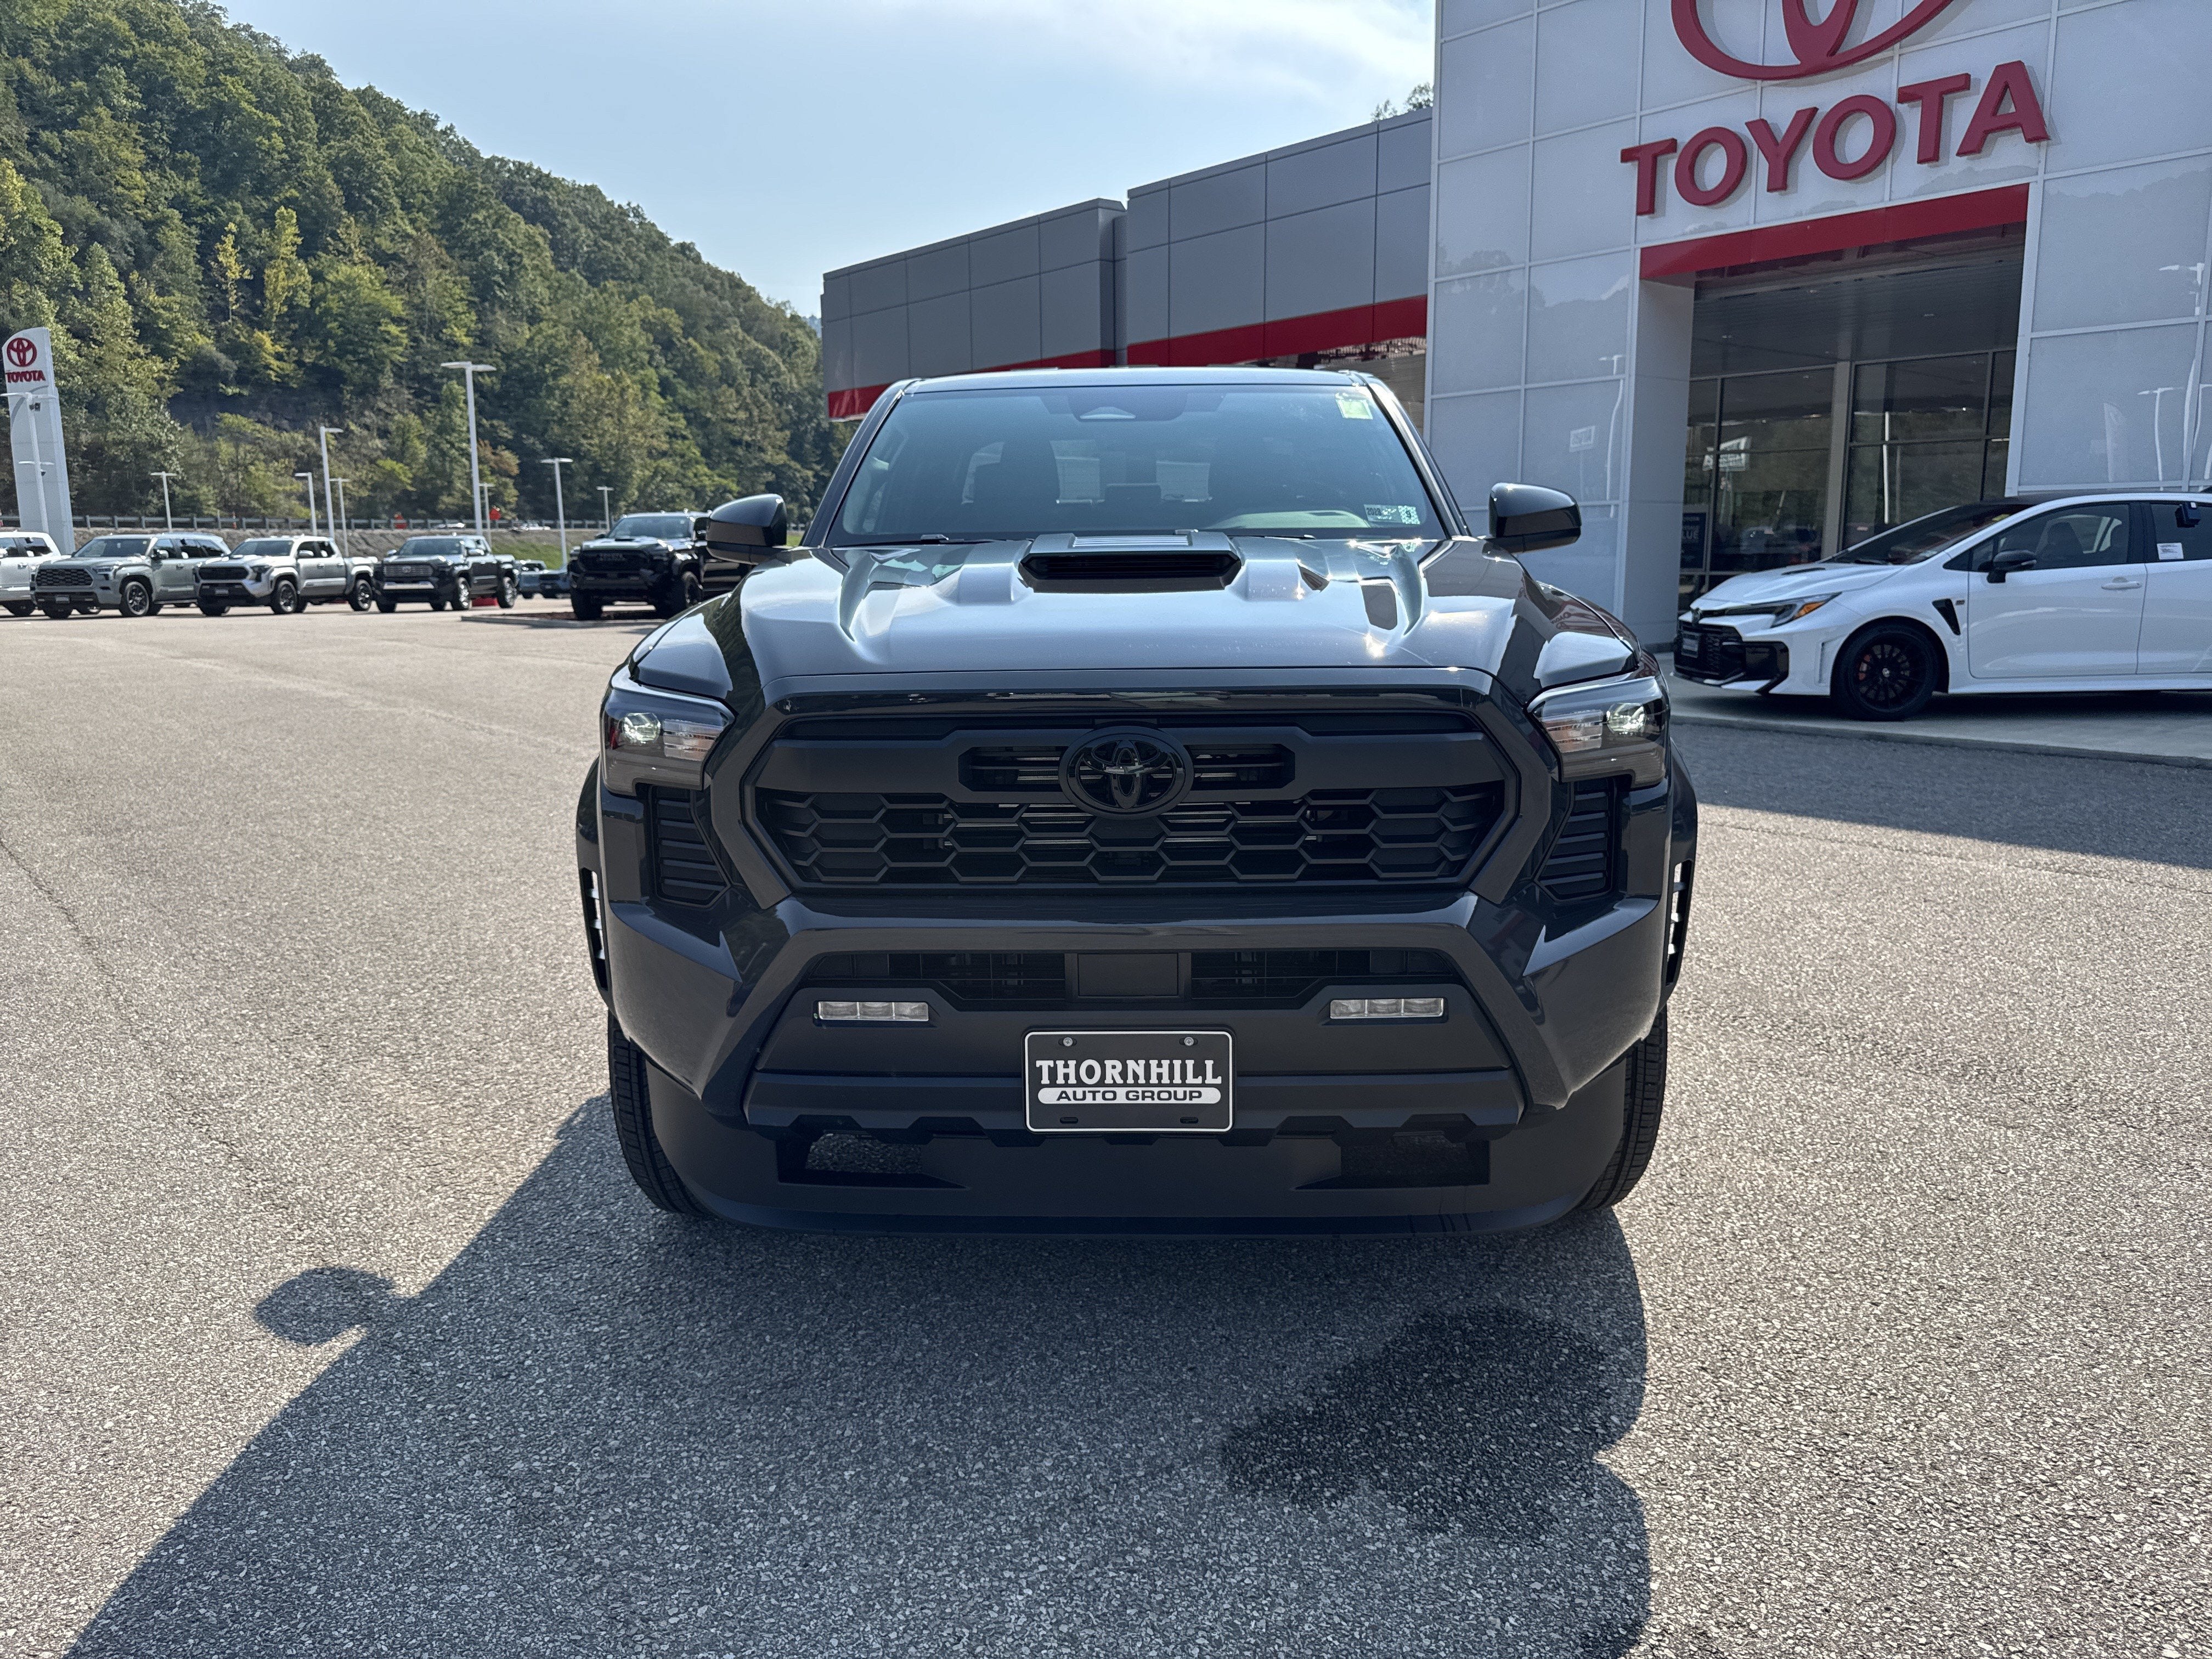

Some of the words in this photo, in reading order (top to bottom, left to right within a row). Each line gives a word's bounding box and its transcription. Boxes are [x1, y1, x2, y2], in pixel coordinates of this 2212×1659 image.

[1620, 60, 2050, 216] TOYOTA
[5, 370, 46, 383] TOYOTA
[1035, 1059, 1222, 1085] THORNHILL
[1056, 1090, 1117, 1102] AUTO
[1125, 1090, 1203, 1102] GROUP
